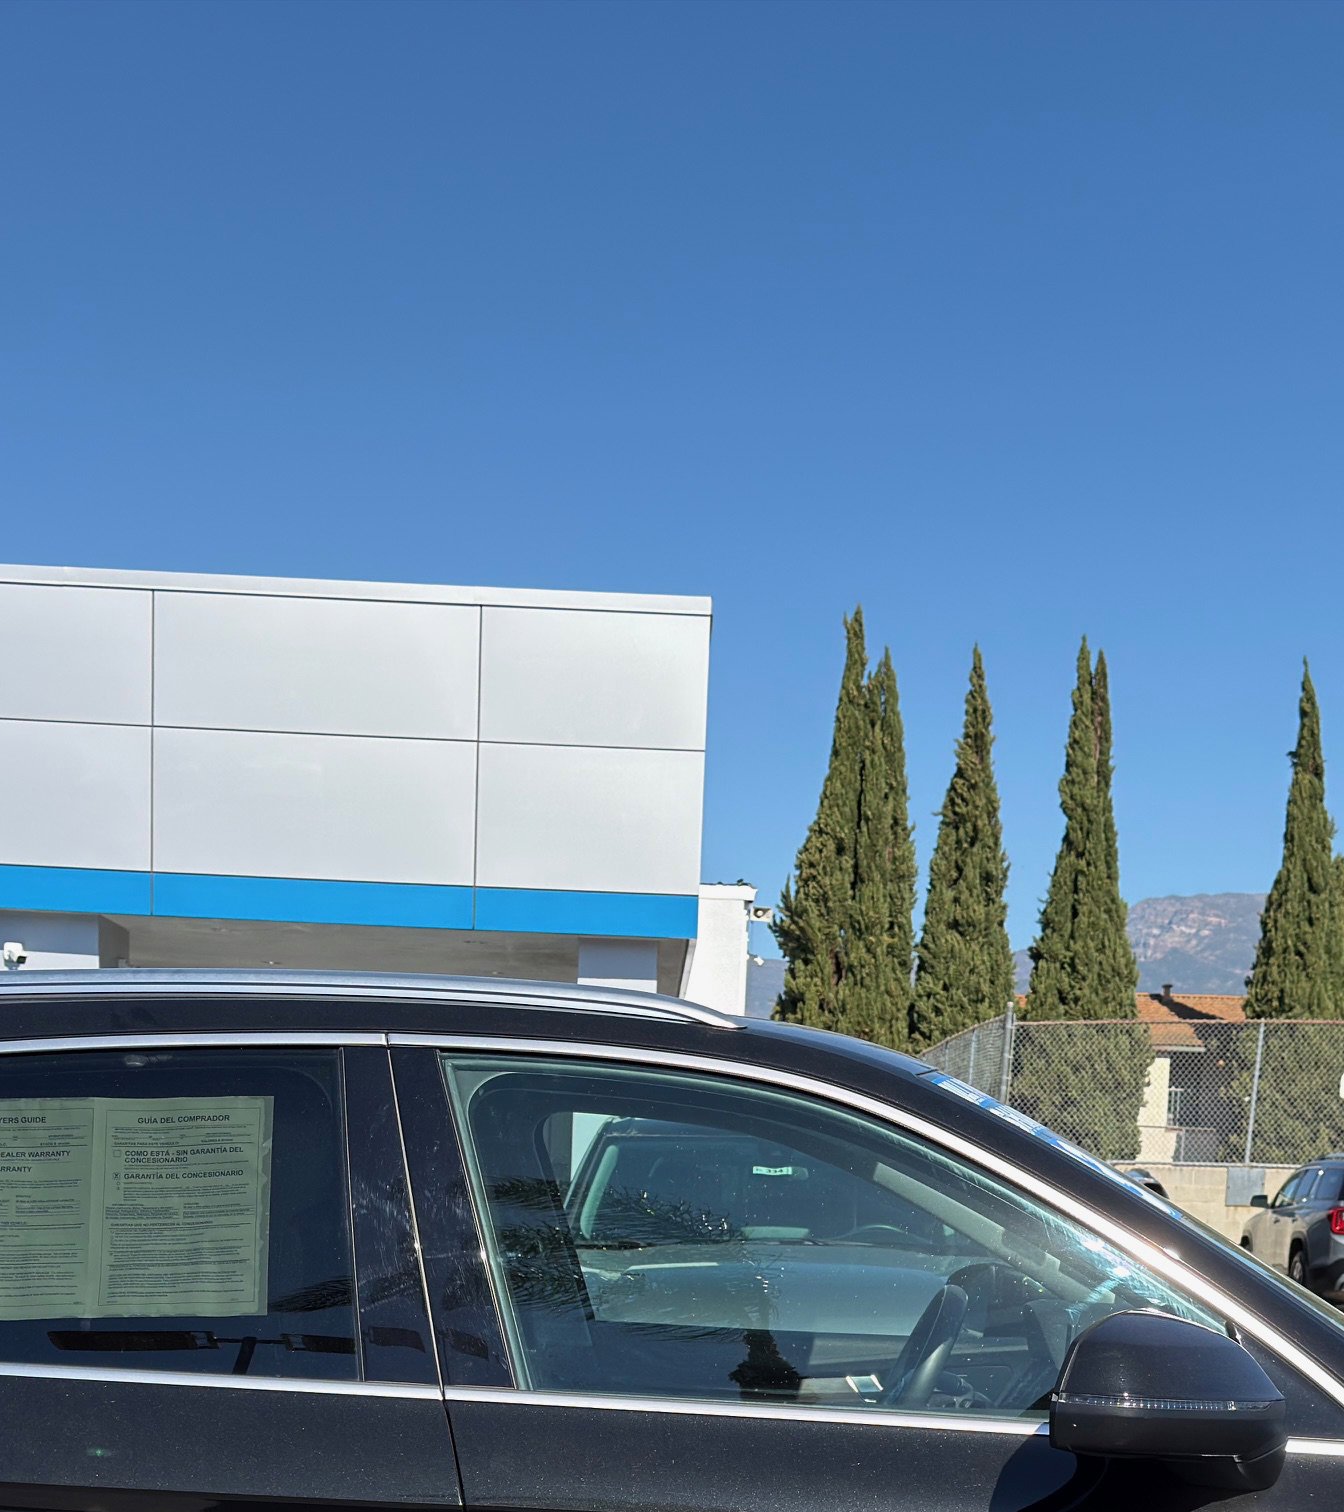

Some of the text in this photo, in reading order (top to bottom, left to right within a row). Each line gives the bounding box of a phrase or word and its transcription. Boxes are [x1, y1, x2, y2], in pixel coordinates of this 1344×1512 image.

[20, 1116, 47, 1124] GUIDE
[160, 1116, 176, 1124] DEL
[177, 1114, 230, 1123] COMPRADOR
[27, 1150, 71, 1158] WARRANTY
[124, 1156, 188, 1164] CONCESIONARIO
[165, 1172, 180, 1180] DEL
[181, 1169, 244, 1179] CONCESIONARIO
